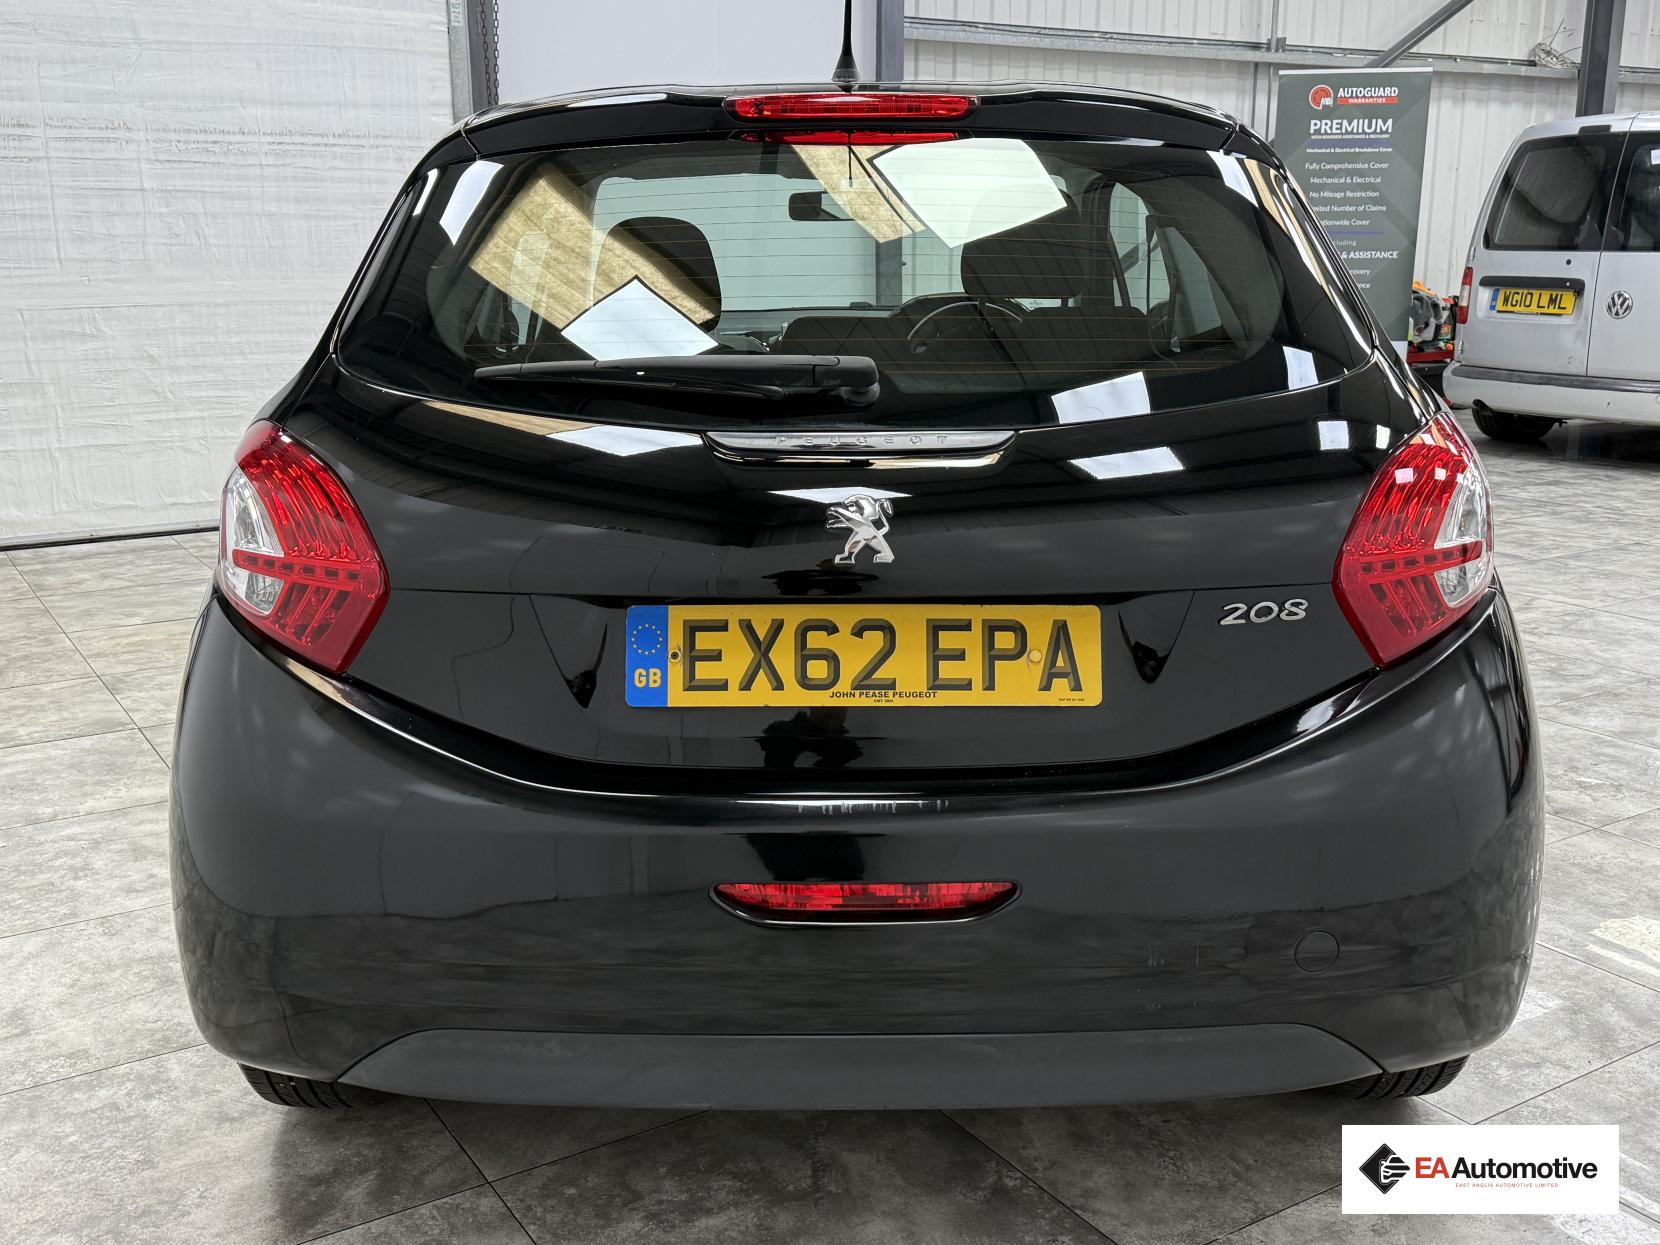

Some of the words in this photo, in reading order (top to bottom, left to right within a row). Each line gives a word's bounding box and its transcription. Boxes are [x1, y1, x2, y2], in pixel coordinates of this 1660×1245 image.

[1338, 87, 1398, 97] AUTOGUARD
[1310, 118, 1393, 134] PREMIUM
[1305, 162, 1320, 170] Fully
[1321, 162, 1369, 170] Comprehensive
[1370, 161, 1389, 169] Cover
[1310, 176, 1345, 184] Mechanical
[1353, 175, 1381, 183] Electrical
[1320, 191, 1345, 199] Mileage
[1332, 204, 1356, 212] Number
[1351, 218, 1370, 226] Cover
[1349, 250, 1398, 259] ASSISTANCE
[1502, 291, 1534, 308] WG10
[1536, 292, 1567, 310] LML
[776, 434, 948, 446] PEUGEOT
[1219, 598, 1309, 625] 208
[682, 618, 897, 691] EX62
[926, 618, 1083, 691] EPA
[634, 668, 661, 687] GB
